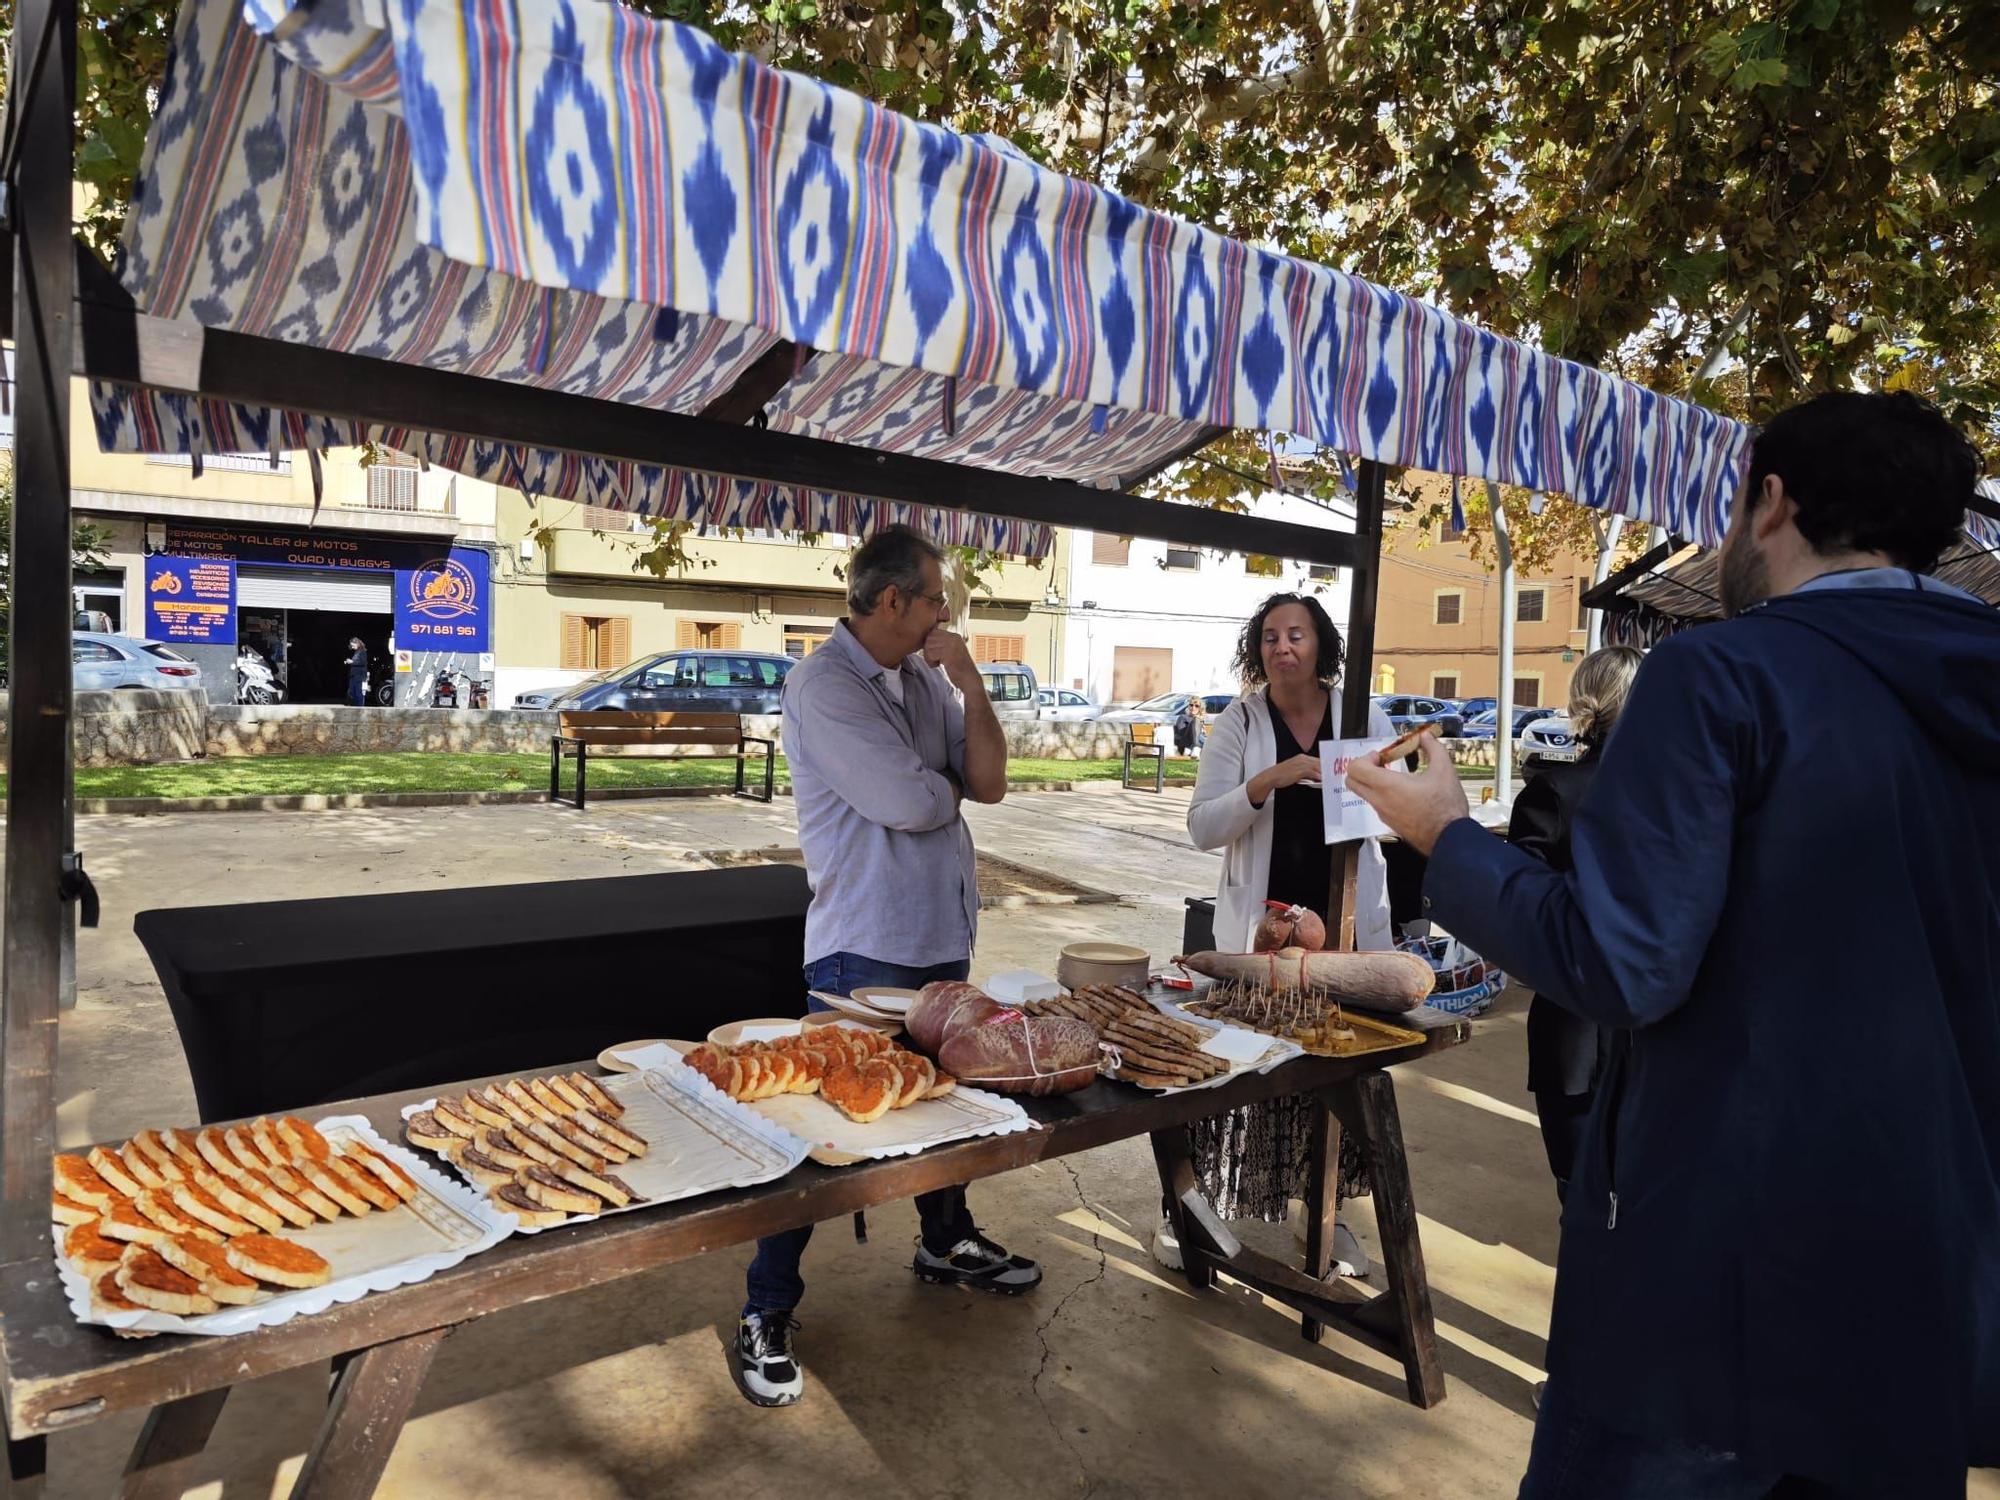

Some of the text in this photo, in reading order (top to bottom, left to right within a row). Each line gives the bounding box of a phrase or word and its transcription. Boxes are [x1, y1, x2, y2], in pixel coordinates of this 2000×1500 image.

[184, 541, 224, 550] MOTOS
[239, 535, 359, 551] TALLER de MOTOS
[167, 551, 237, 561] MULTIMARCA
[288, 554, 391, 569] QUAD y BUGGYS
[172, 603, 211, 612] Horario
[411, 624, 476, 636] 971 881 961
[1334, 757, 1351, 776] CAS
